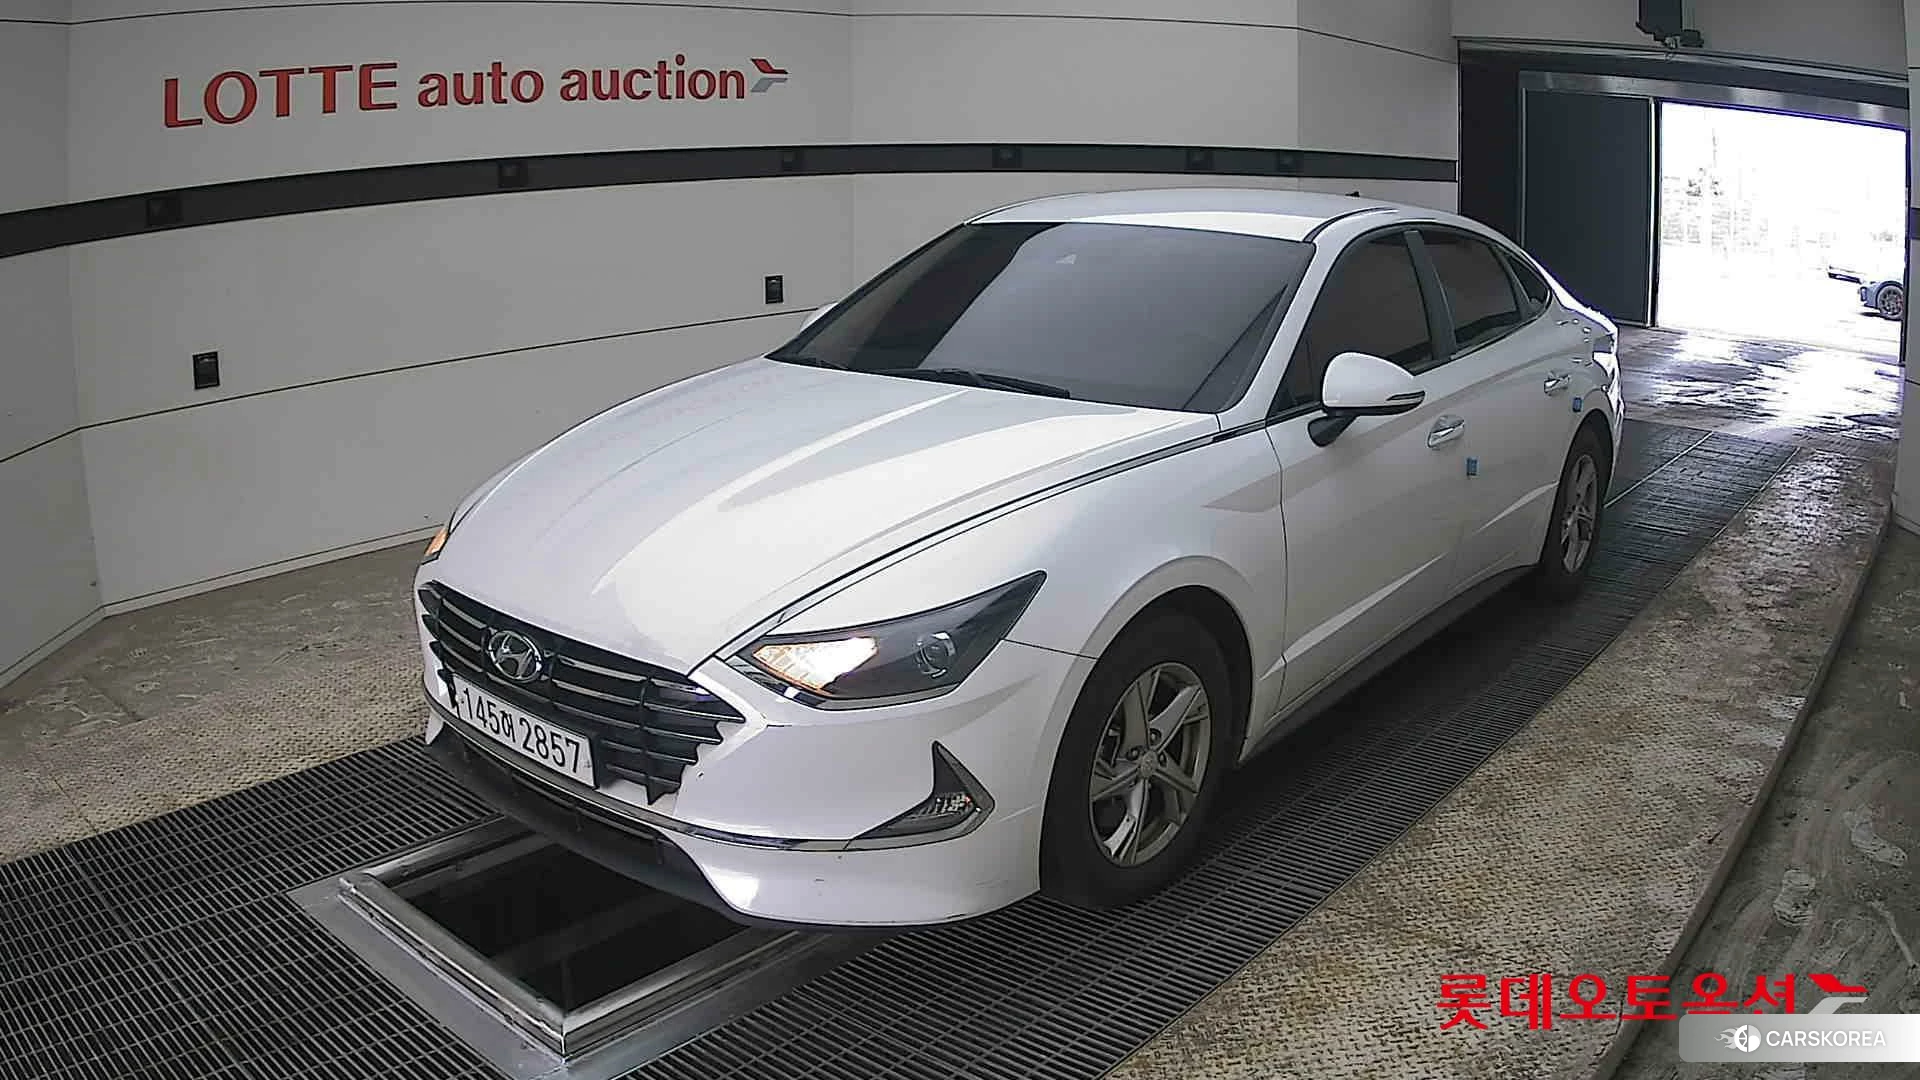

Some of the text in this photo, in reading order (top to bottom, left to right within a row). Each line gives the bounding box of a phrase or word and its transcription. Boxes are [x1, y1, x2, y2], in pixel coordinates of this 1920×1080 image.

[163, 54, 746, 128] LOTTE auto auction
[519, 717, 581, 774] 2857
